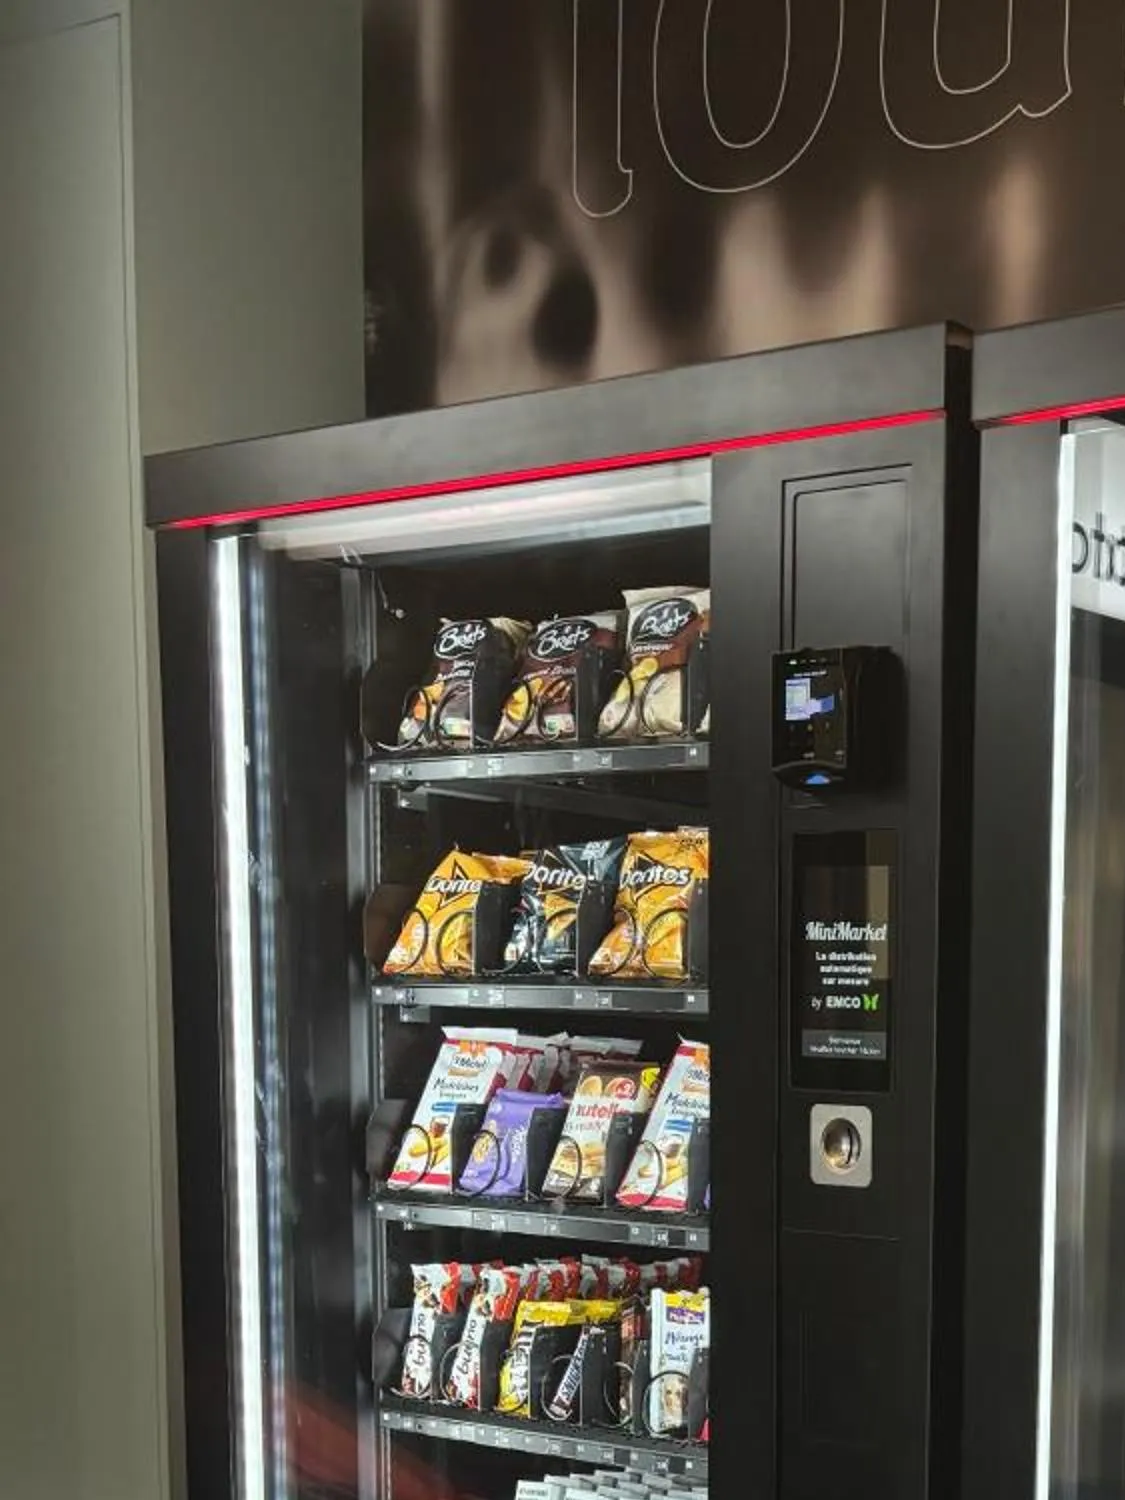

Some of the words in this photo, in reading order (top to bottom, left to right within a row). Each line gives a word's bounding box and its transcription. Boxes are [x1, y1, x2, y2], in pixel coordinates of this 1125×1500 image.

[427, 877, 482, 893] Dorito
[805, 920, 888, 941] MiniMarket
[825, 995, 861, 1009] EMCO
